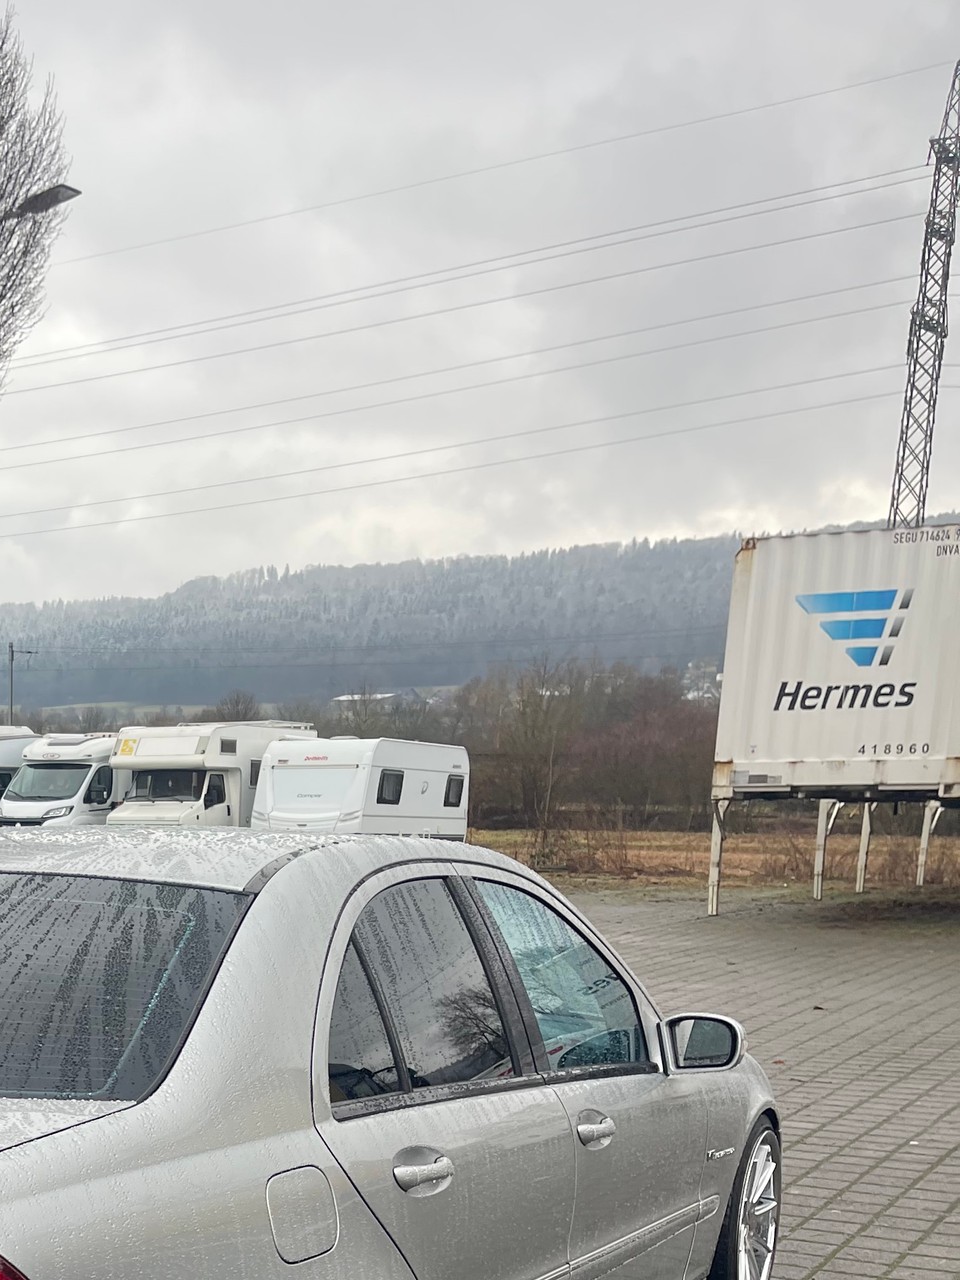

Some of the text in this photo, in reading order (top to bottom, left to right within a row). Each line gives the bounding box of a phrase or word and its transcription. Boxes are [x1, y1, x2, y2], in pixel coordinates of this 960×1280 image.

[893, 532, 918, 544] SEGU
[920, 530, 950, 542] 714624
[773, 681, 917, 711] Hermes
[858, 743, 929, 755] 418960
